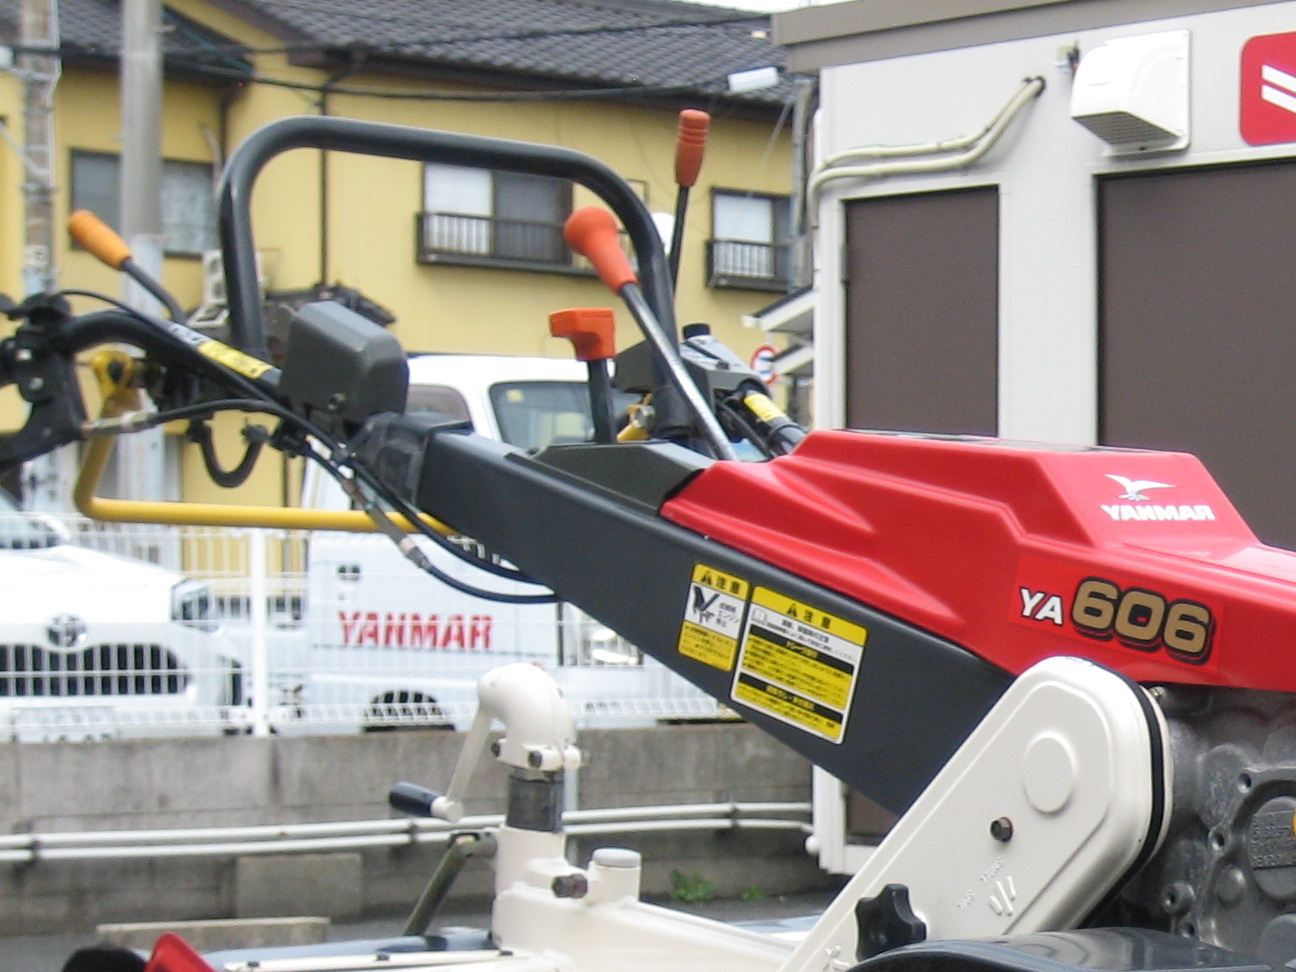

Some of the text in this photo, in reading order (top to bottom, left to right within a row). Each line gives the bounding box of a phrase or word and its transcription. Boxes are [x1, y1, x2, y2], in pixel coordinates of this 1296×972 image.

[1101, 504, 1215, 521] YANMAR
[338, 610, 494, 651] YANMAR
[1019, 576, 1216, 666] YA 606
